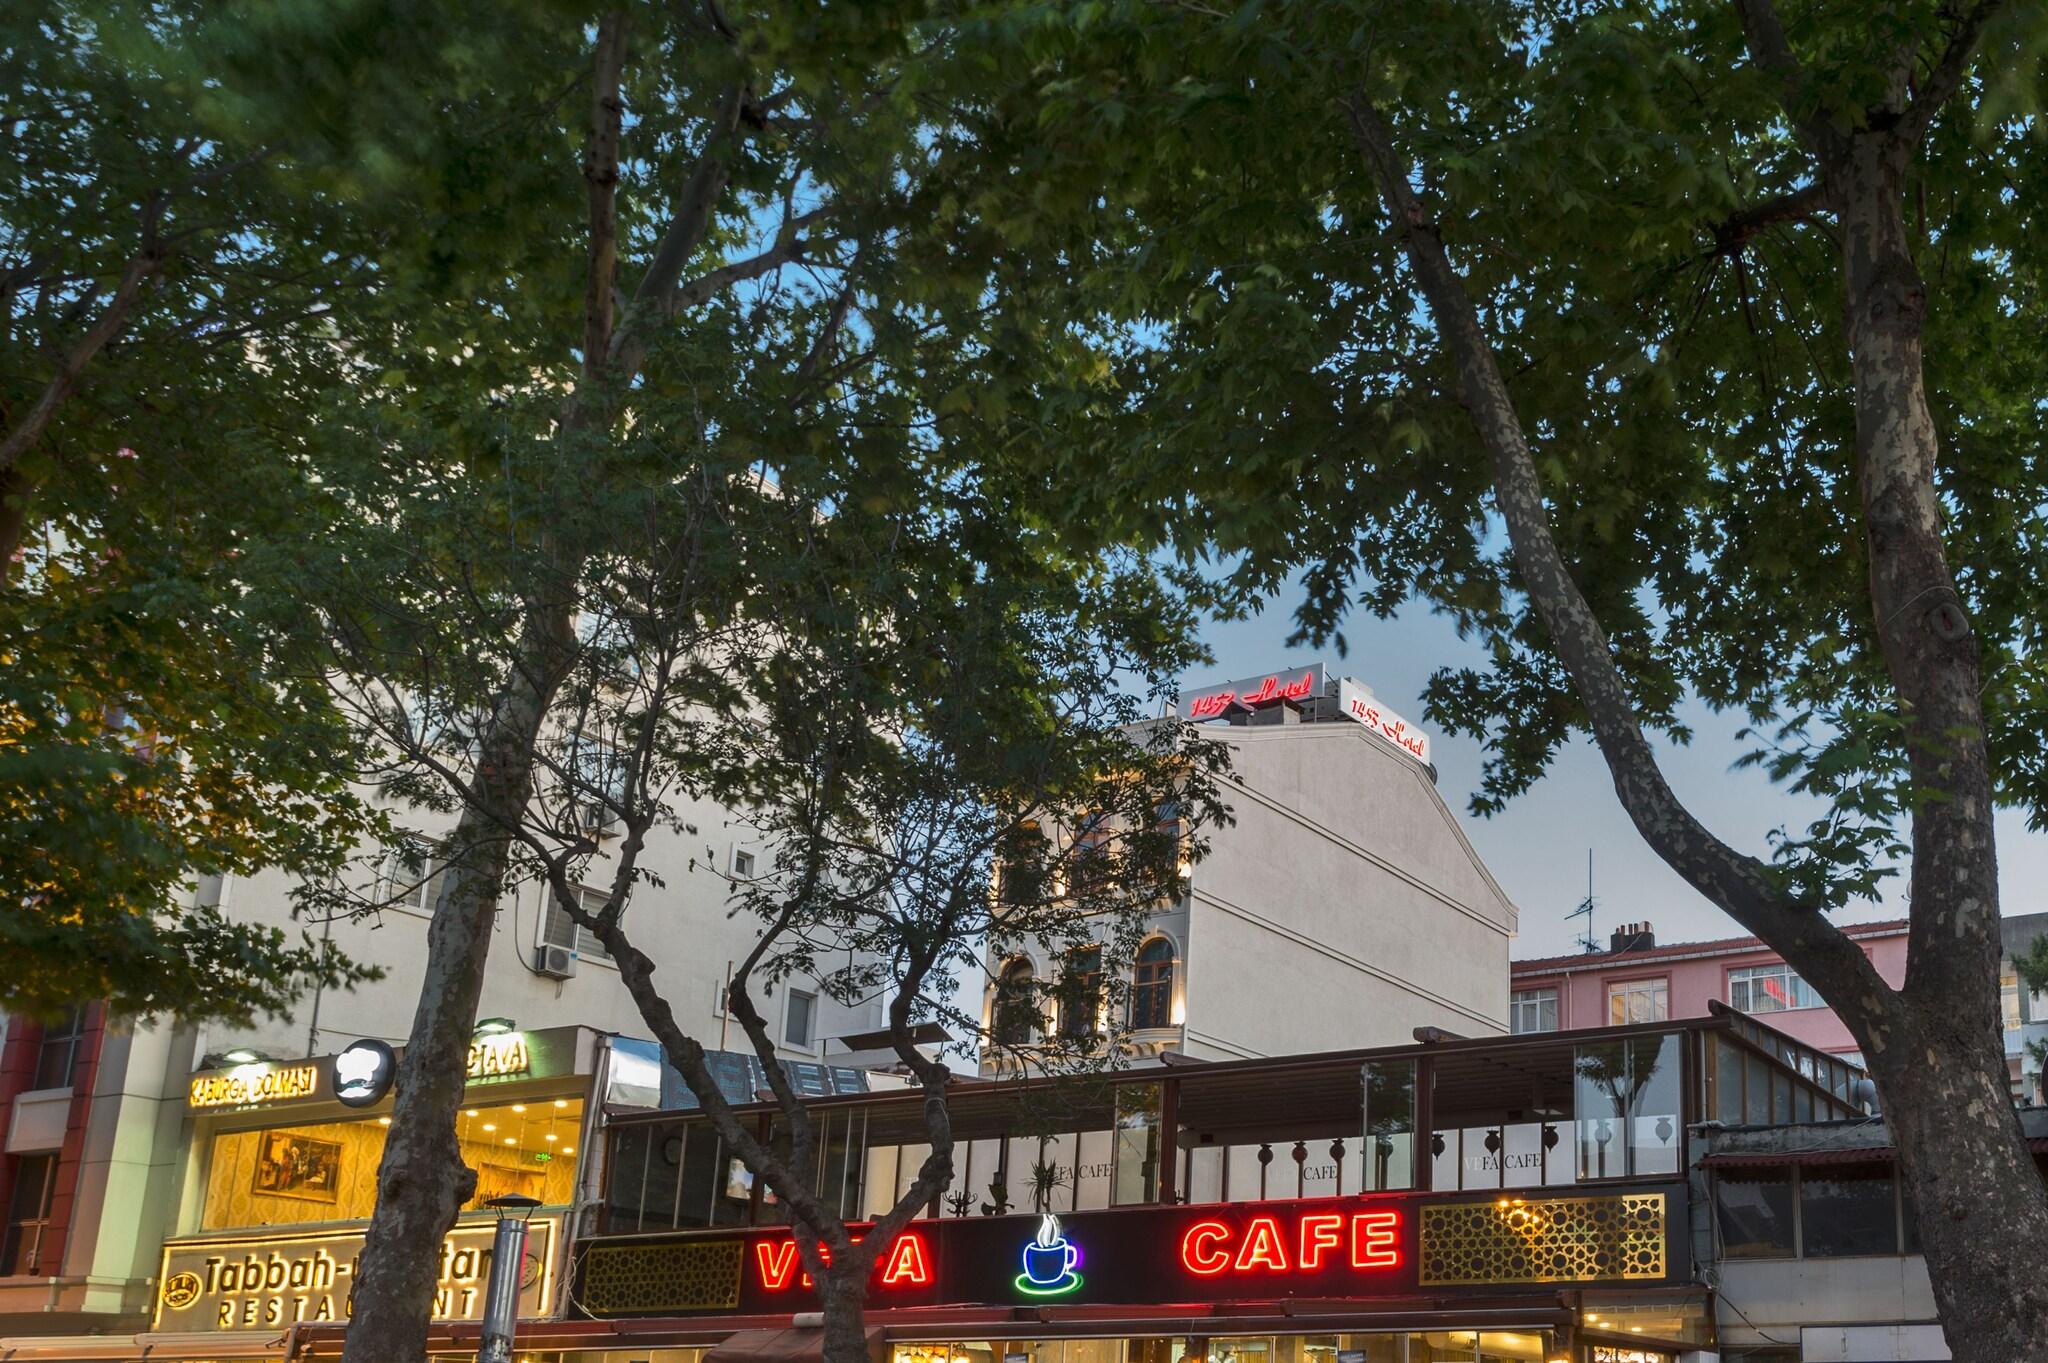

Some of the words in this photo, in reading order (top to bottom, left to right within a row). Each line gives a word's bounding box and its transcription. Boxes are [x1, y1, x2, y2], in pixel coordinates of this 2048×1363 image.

[1382, 720, 1425, 757] Hotel
[1078, 1163, 1112, 1179] CAFE
[1303, 1165, 1337, 1180] CAFE
[1504, 1153, 1542, 1169] CAFE
[757, 1236, 926, 1288] VA
[1183, 1213, 1397, 1274] CAFE
[217, 1289, 474, 1326] RESTANT
